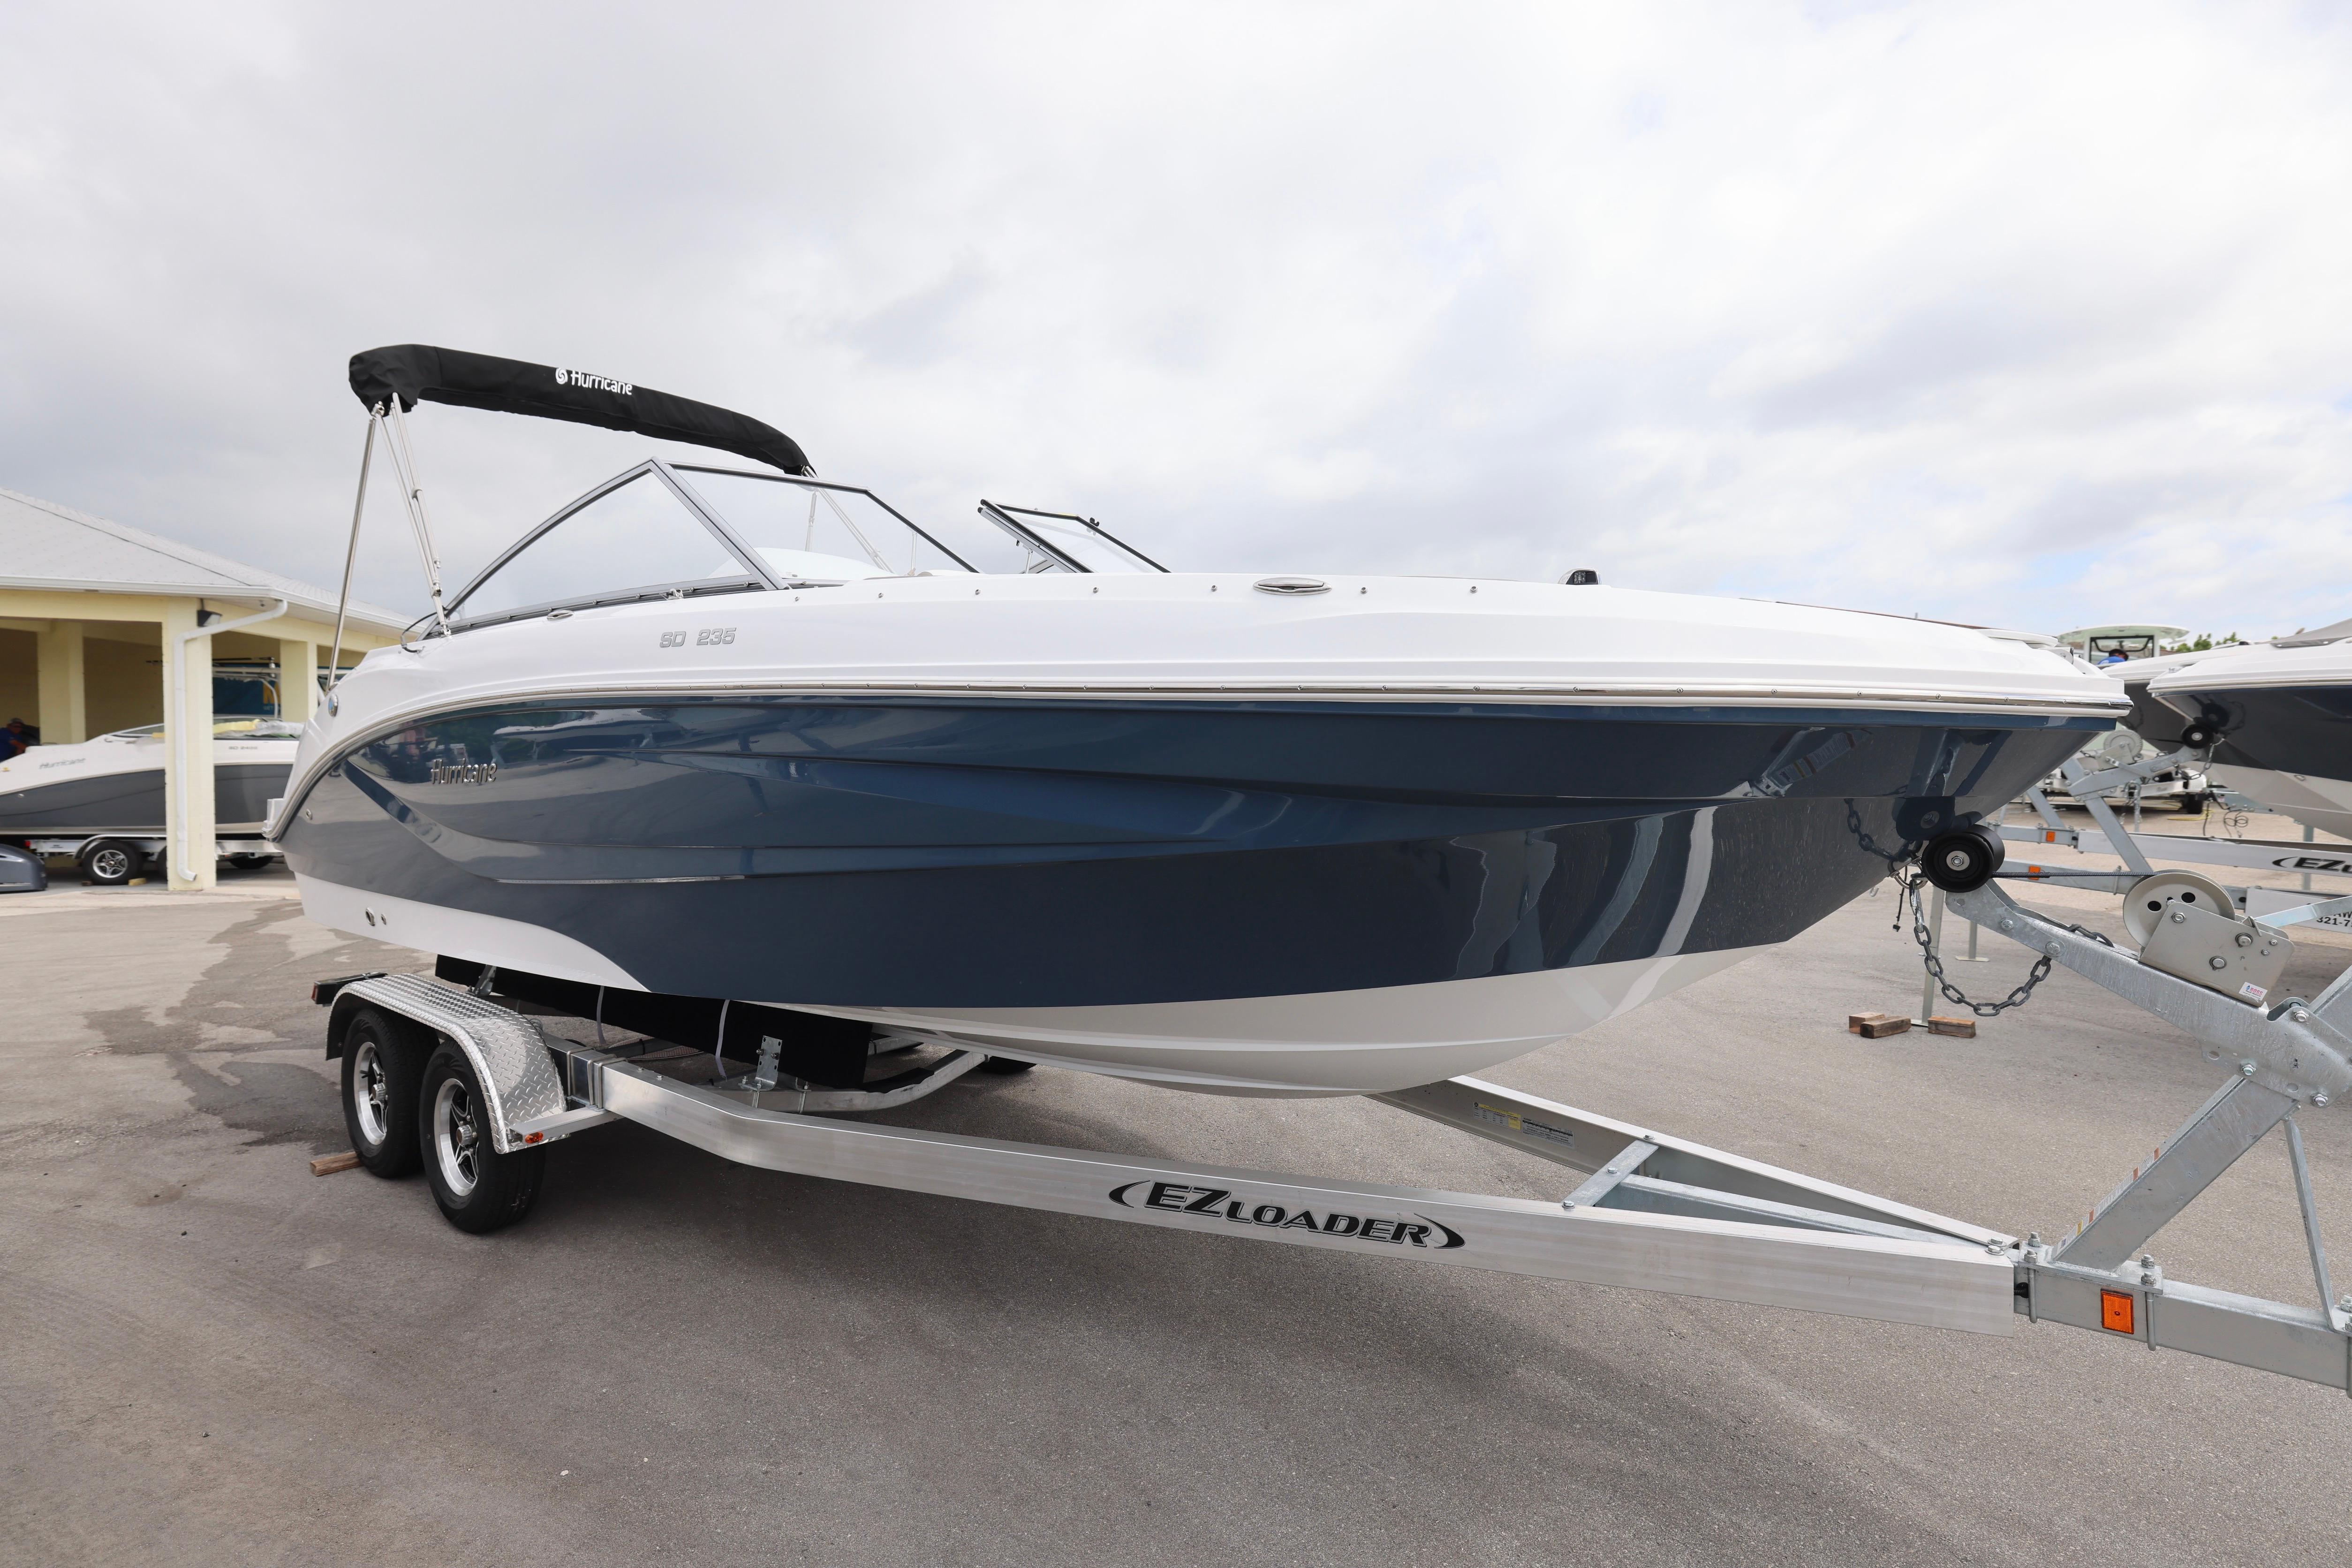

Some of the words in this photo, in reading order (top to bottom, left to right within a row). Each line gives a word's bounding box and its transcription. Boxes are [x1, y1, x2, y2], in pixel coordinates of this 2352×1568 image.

[570, 370, 633, 395] Hurricane
[659, 631, 686, 648] SD
[696, 627, 736, 646] 235
[431, 758, 497, 784] Hurricane
